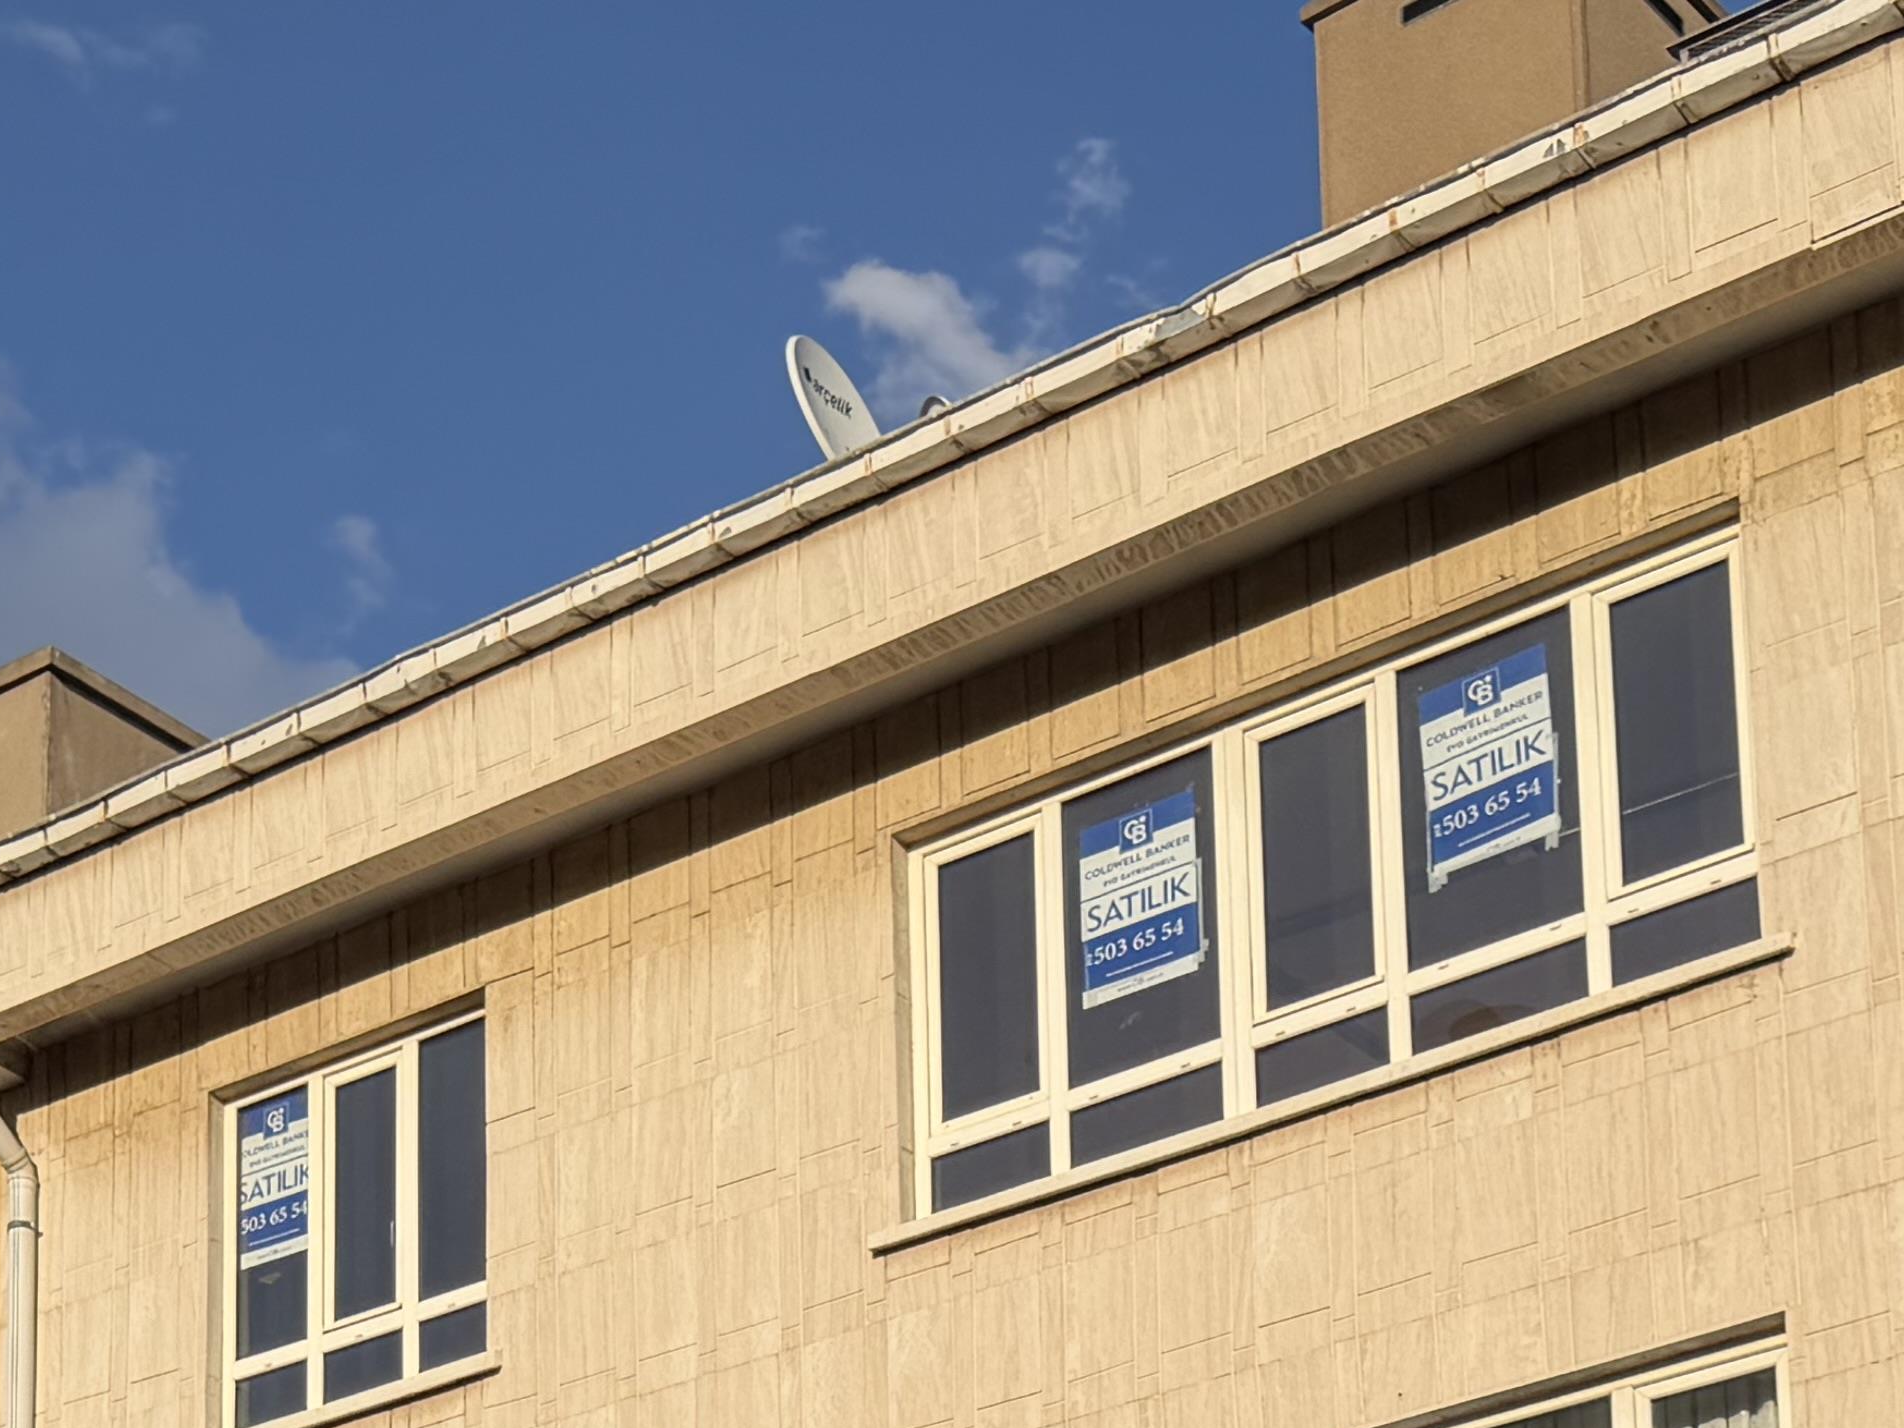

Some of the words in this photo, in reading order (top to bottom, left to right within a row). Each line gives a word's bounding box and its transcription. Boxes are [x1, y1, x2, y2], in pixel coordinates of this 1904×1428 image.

[1426, 713, 1491, 747] COLDWELL
[1494, 691, 1543, 719] BANKER
[1431, 729, 1546, 801] SATILIK
[1442, 804, 1479, 836] 503
[1484, 790, 1510, 816] 65
[1516, 777, 1542, 803] 54
[1085, 853, 1143, 881] COLDWELL
[1146, 834, 1190, 858] BANKER
[1088, 871, 1191, 933] SATILIK
[1094, 938, 1127, 965] 503
[1132, 928, 1156, 951] 65
[1161, 917, 1184, 941] 54
[241, 1213, 266, 1235] 503
[269, 1206, 287, 1226] 65
[291, 1200, 307, 1219] 54
